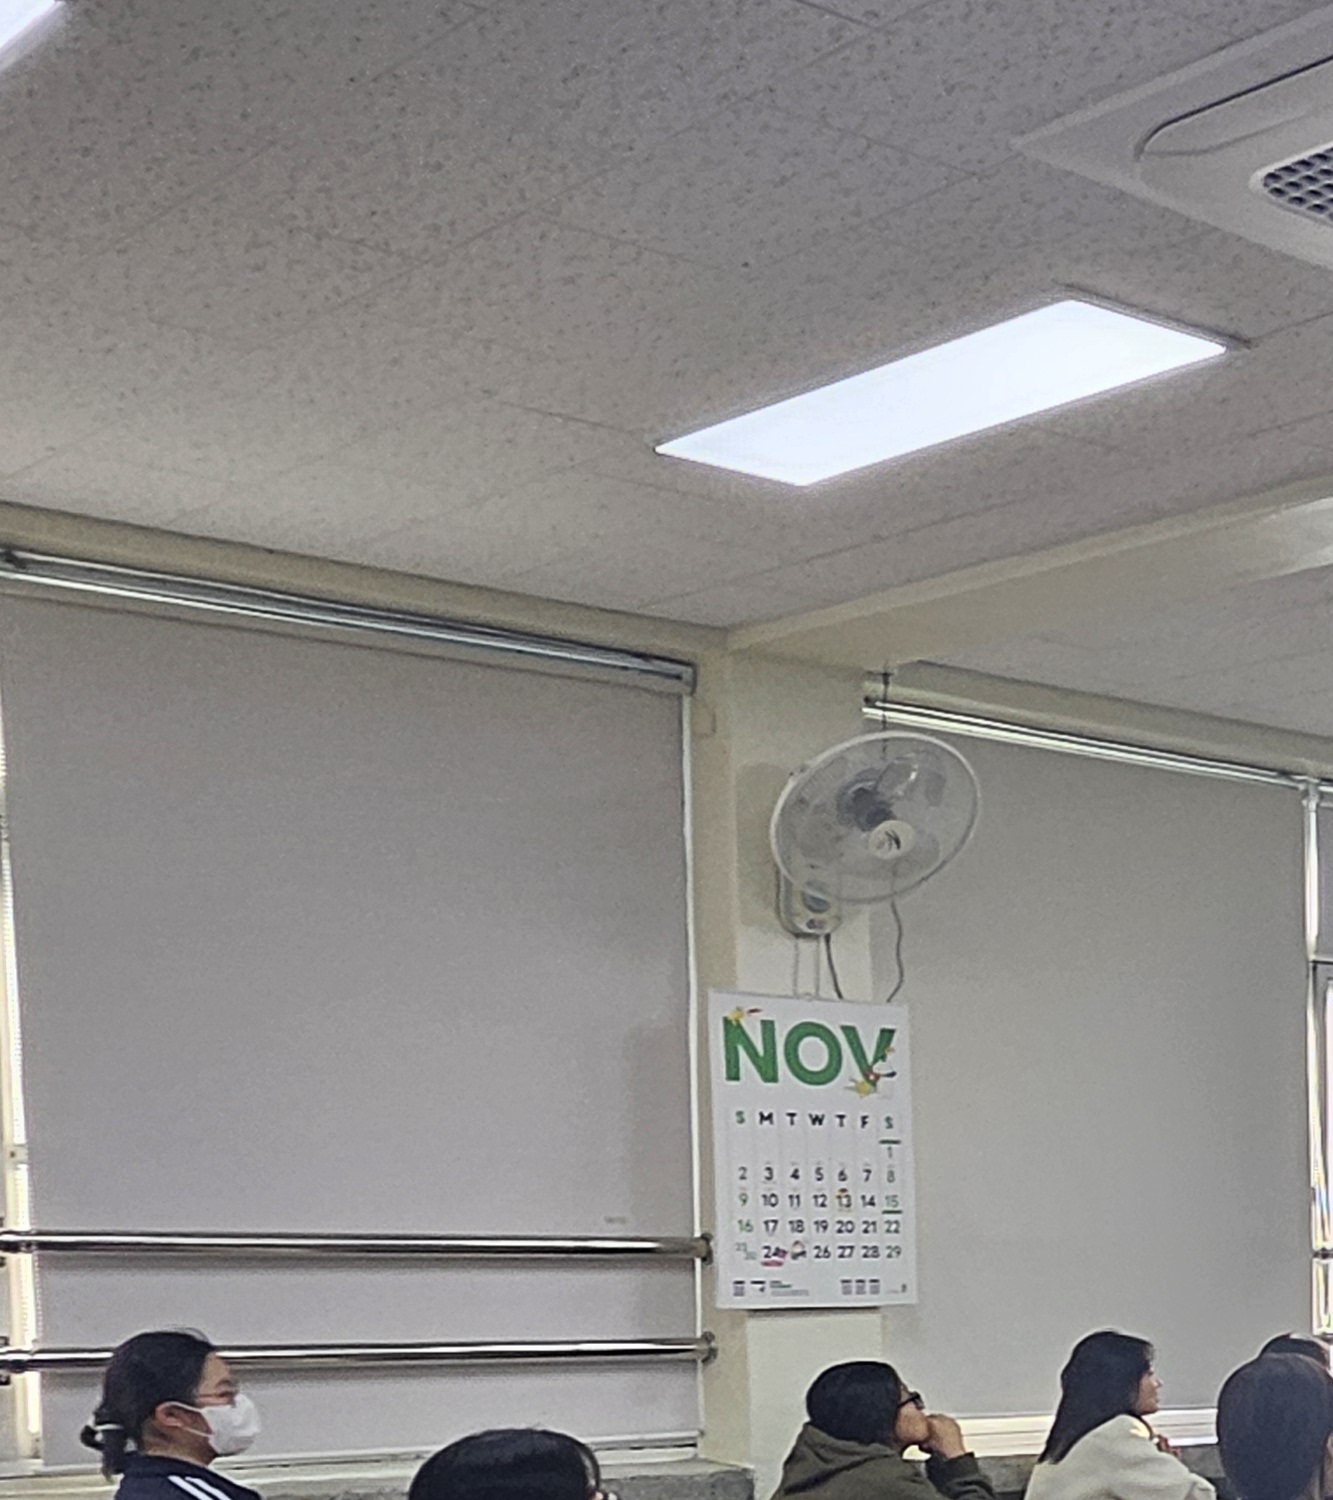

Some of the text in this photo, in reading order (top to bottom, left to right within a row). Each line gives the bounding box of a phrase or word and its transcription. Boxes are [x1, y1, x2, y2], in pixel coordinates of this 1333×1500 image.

[722, 1016, 897, 1086] NOV
[759, 1112, 774, 1125] M
[786, 1113, 797, 1126] T
[808, 1113, 825, 1126] W
[835, 1114, 846, 1127] T
[861, 1115, 869, 1128] F
[738, 1167, 895, 1183] 2 3 4 5 6 7 8
[738, 1194, 899, 1208] 9 10 11 12 13 14 15
[738, 1220, 900, 1234] 16 17 18 19 20 21 22
[813, 1246, 831, 1259] 26
[838, 1246, 855, 1259] 27
